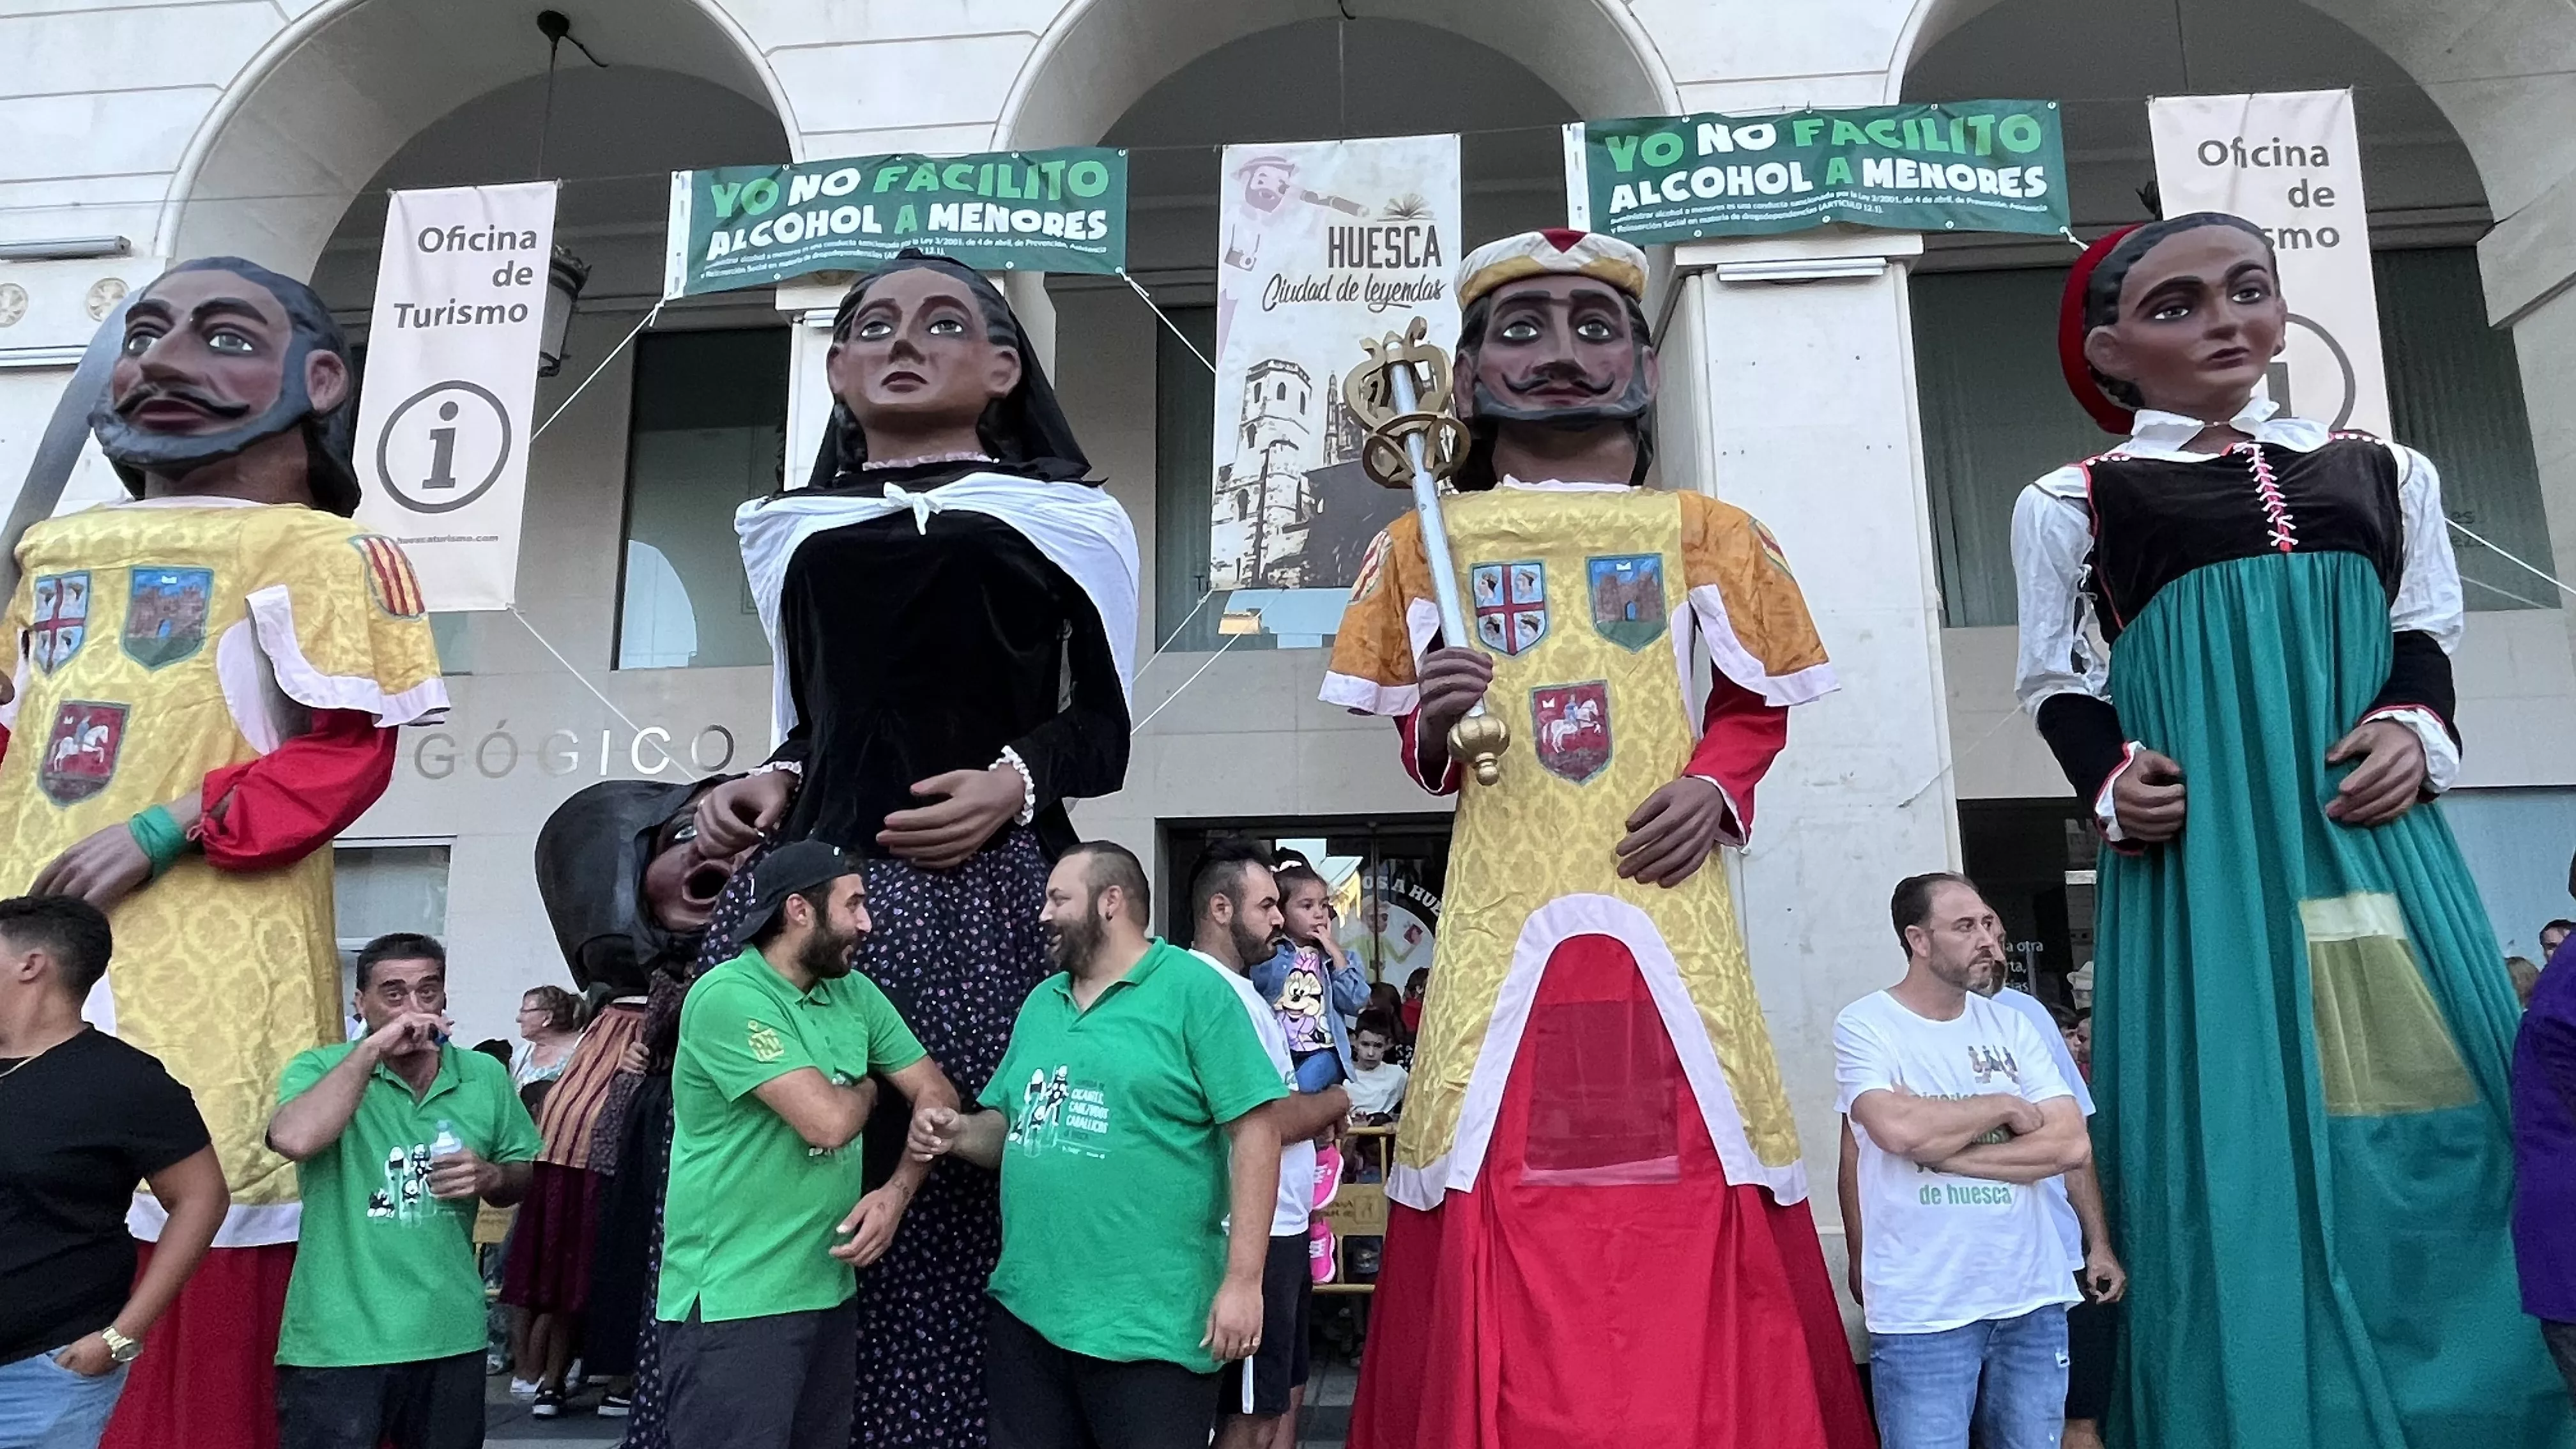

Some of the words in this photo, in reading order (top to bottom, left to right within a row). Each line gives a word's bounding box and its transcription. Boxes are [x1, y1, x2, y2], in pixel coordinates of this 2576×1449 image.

[1605, 132, 1684, 172] YO
[1697, 123, 1777, 156] NO
[1793, 114, 2041, 156] FACILITO
[2198, 137, 2329, 169] Oficina
[710, 178, 779, 217] YO
[787, 167, 861, 206] NO
[873, 160, 1109, 201] FACILITO
[1609, 161, 1814, 214] ALCOHOL
[1825, 157, 1853, 185] A
[1862, 157, 2048, 199] MENORES
[2287, 178, 2335, 208] de
[418, 224, 537, 253] Oficina
[706, 204, 882, 261] ALCOHOL
[894, 202, 918, 234] A
[928, 202, 1108, 240] MENORES
[1328, 225, 1442, 268] HUESCA
[493, 260, 533, 287] de
[1262, 273, 1334, 312] Ciudad
[1336, 273, 1359, 302] de
[1364, 273, 1446, 312] leyendas
[394, 298, 528, 328] Turismo
[1919, 1185, 1942, 1205] de
[1947, 1183, 2012, 1204] huesca
